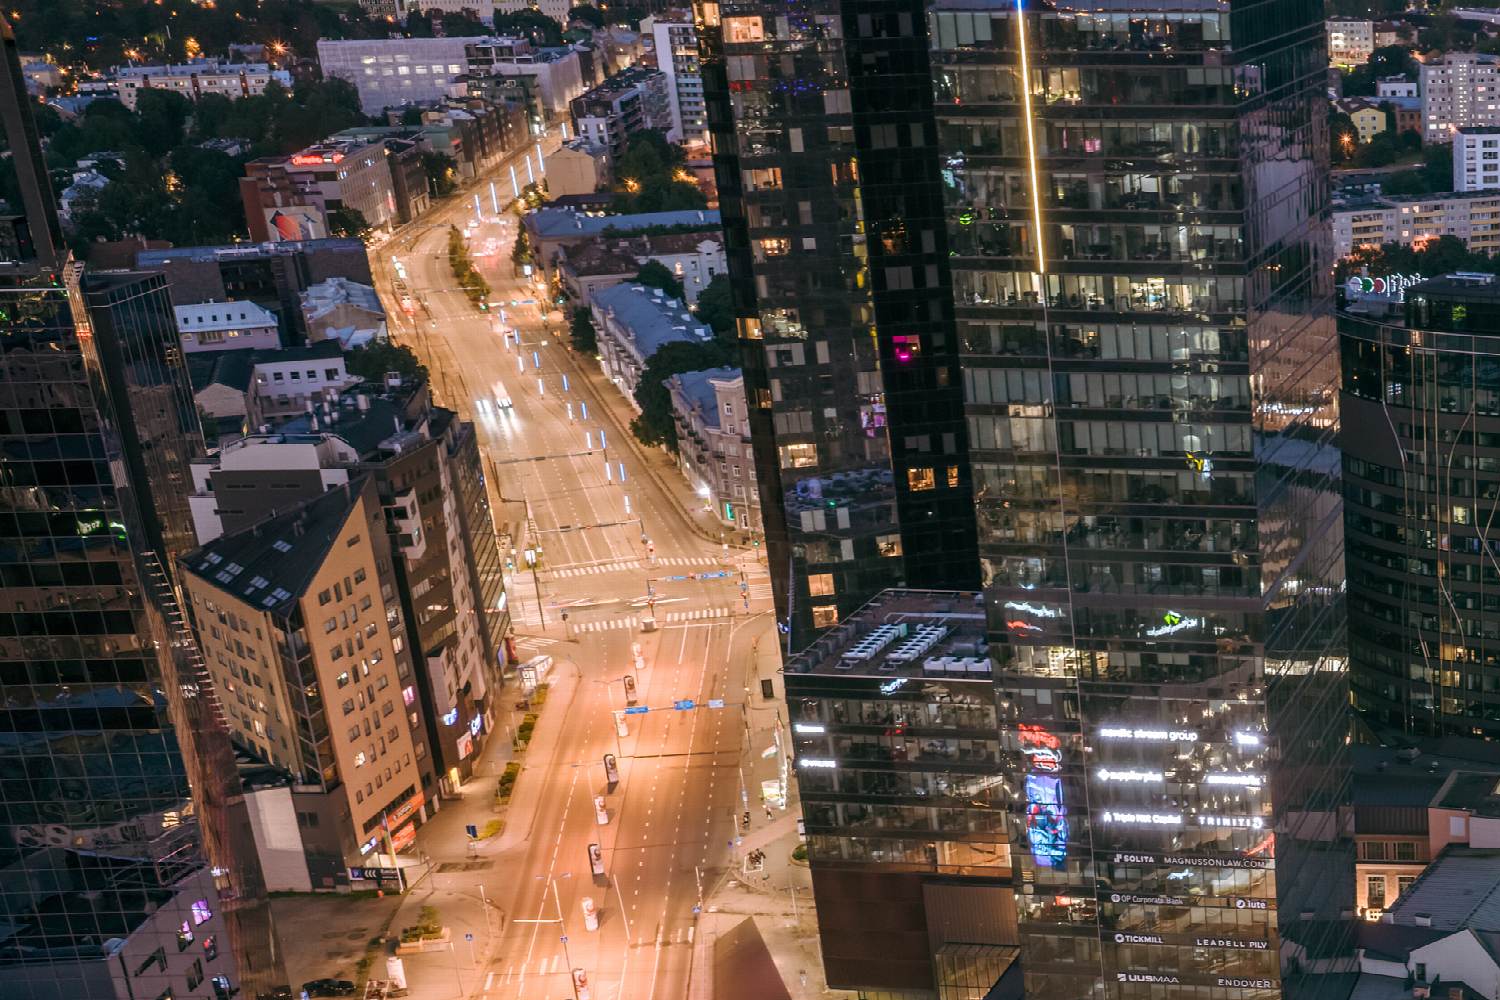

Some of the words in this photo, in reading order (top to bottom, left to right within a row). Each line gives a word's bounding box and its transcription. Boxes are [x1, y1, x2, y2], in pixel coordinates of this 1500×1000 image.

[1169, 730, 1198, 742] group
[1199, 816, 1251, 827] TRINITI
[1123, 854, 1154, 863] SOLITA
[1164, 856, 1265, 868] MAGNUSSONLAW.COM
[1121, 895, 1131, 903] OP
[1132, 895, 1165, 905] Corporate
[1125, 935, 1164, 944] TICKMILL
[1197, 938, 1246, 947] LEADELL
[1249, 941, 1267, 949] PILV
[1128, 974, 1180, 984] UUSMAA
[1218, 978, 1271, 988] ENDOVER
